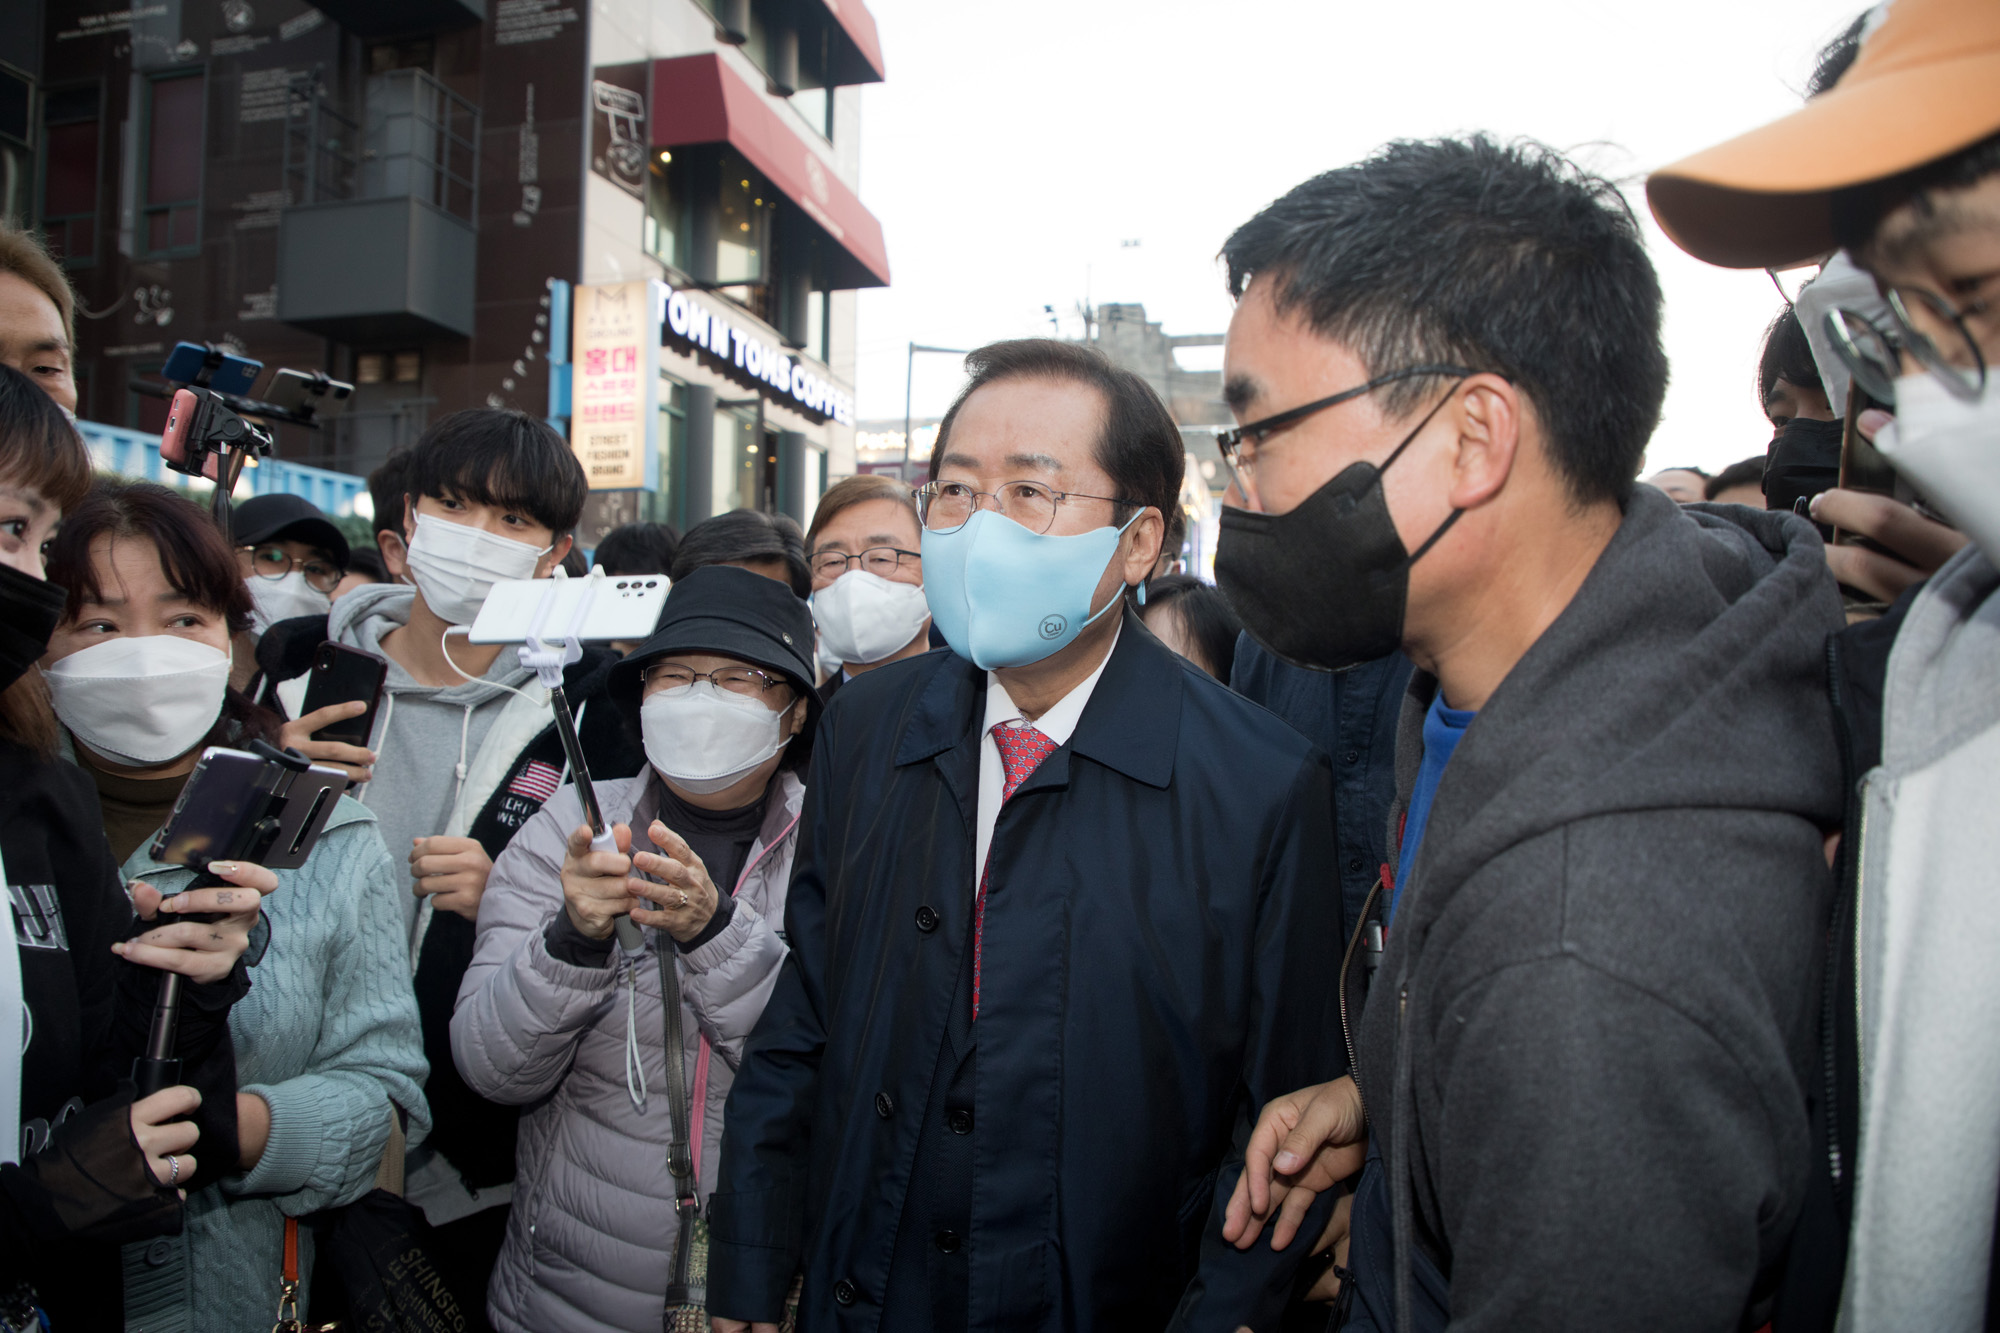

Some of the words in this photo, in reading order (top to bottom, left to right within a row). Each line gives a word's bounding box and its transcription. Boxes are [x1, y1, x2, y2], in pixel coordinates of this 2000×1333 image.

[585, 346, 636, 375] 홍대
[651, 277, 709, 348] TOM
[710, 314, 730, 359] N
[731, 326, 791, 393] TOMS
[791, 364, 854, 427] COFFEE
[583, 402, 635, 424] 브랜드
[1045, 622, 1061, 633] Cu
